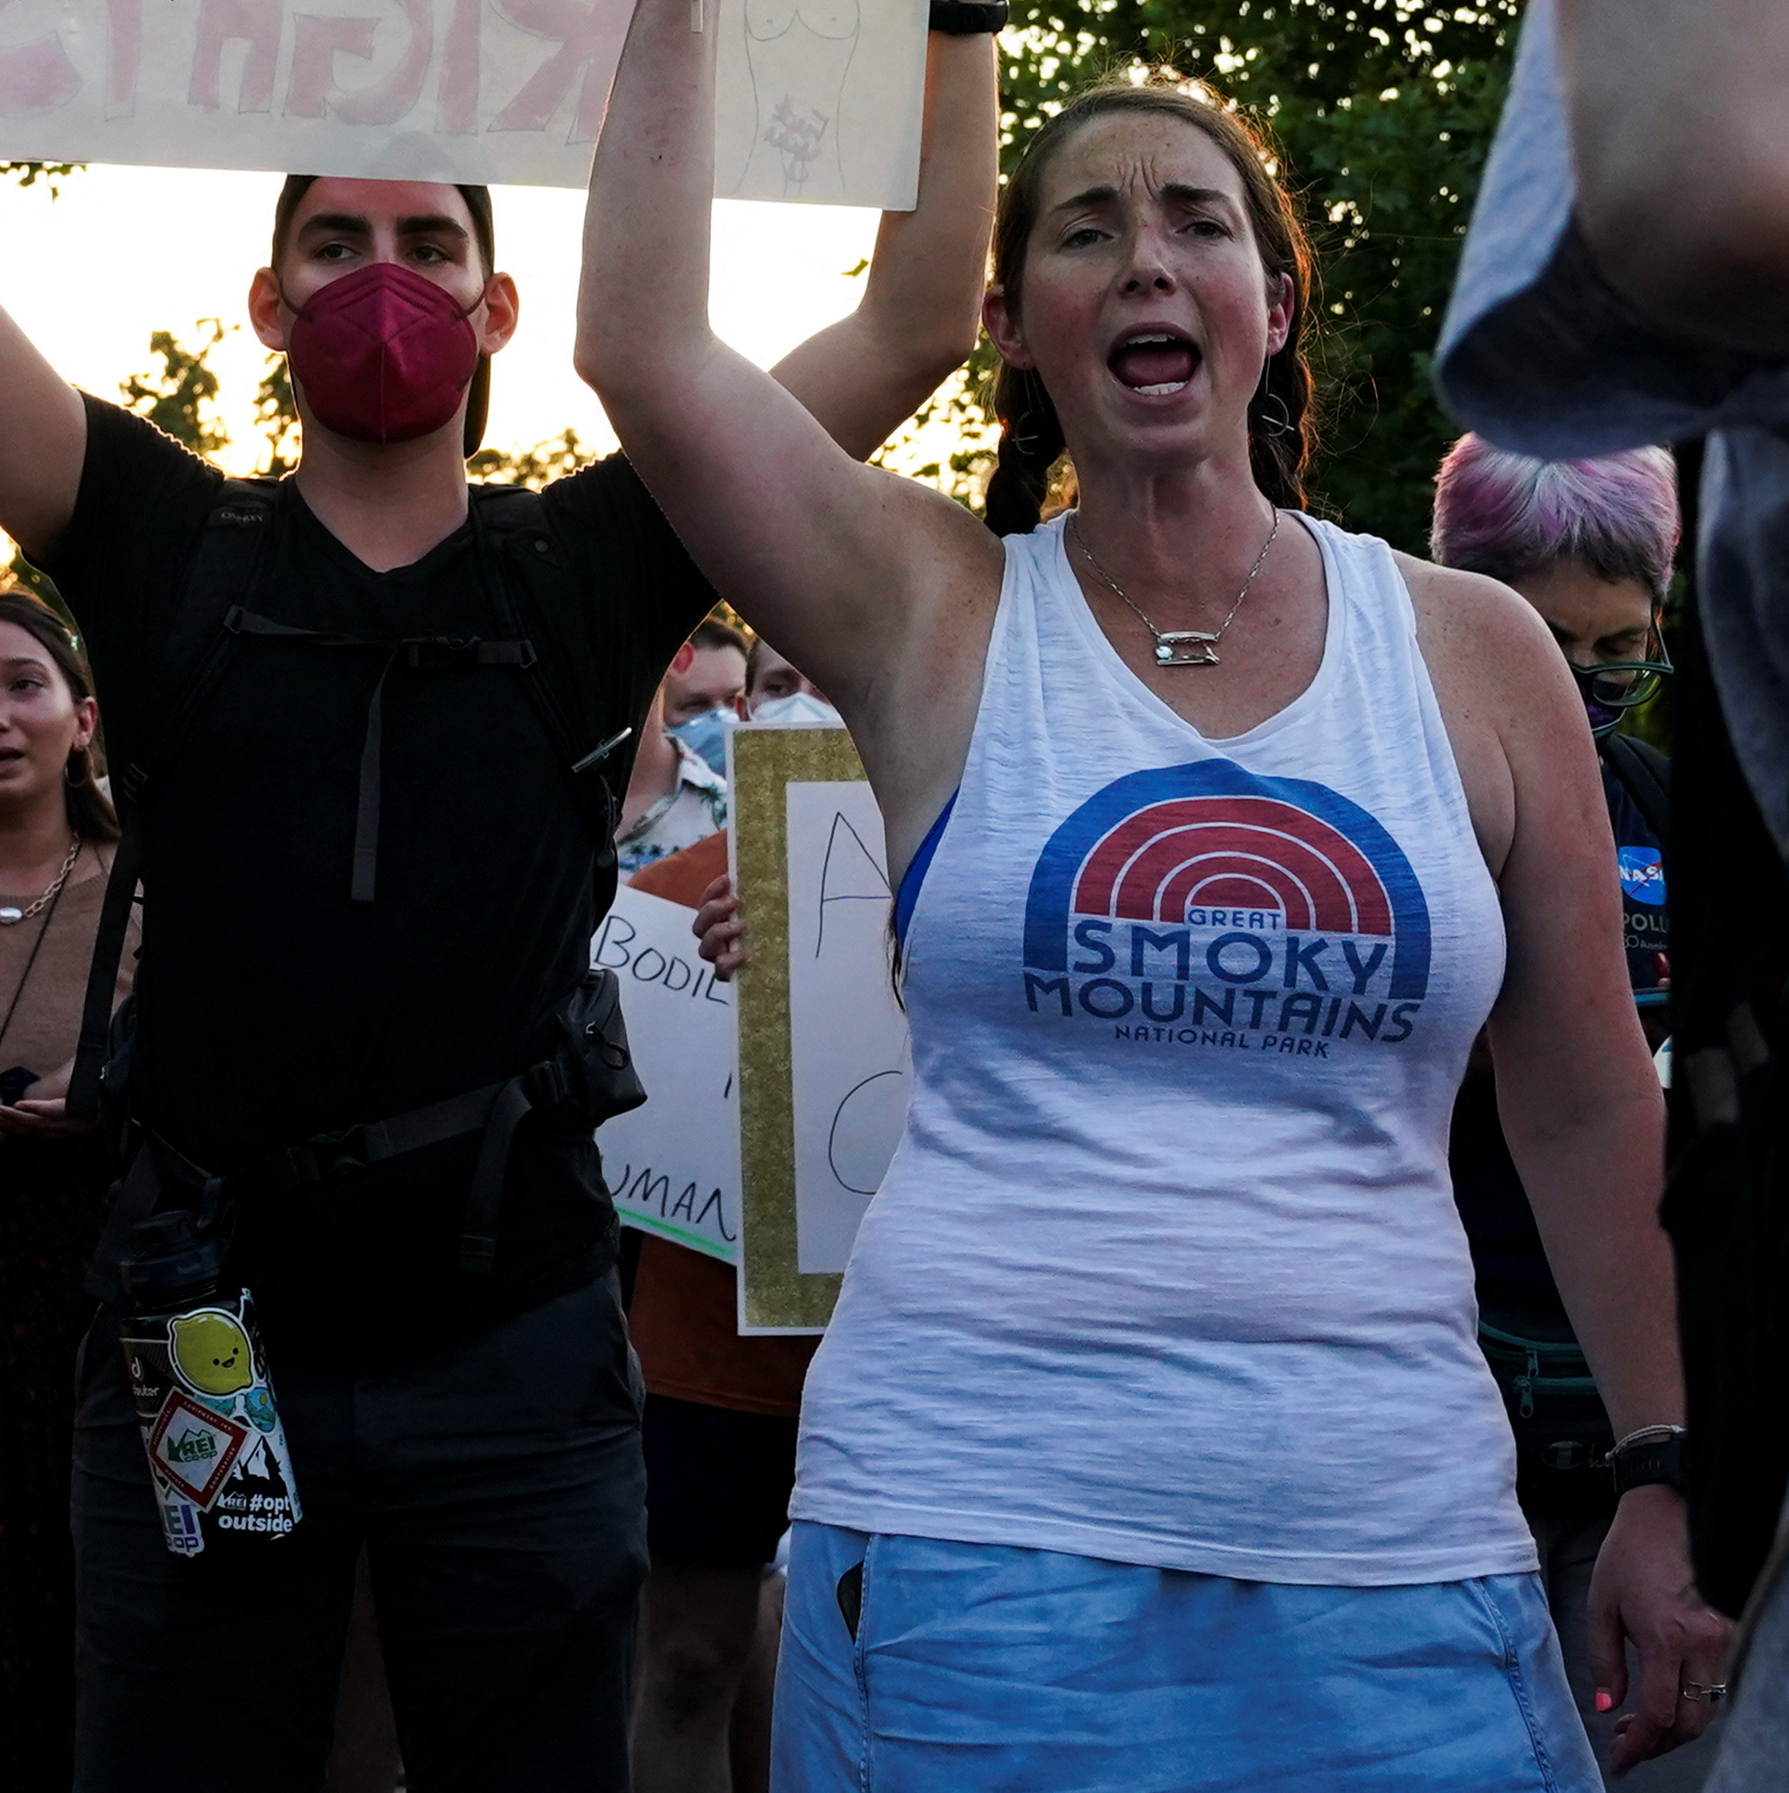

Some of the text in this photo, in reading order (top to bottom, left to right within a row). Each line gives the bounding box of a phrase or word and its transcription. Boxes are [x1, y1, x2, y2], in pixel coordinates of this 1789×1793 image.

[1187, 908, 1281, 930] GREAT
[595, 915, 729, 1005] BODIL
[1073, 919, 1388, 995] SMOKY
[1023, 972, 1421, 1043] MOUNTAINS
[1115, 1024, 1329, 1059] NATIONAL PARK
[249, 1494, 291, 1513] #opt
[218, 1513, 293, 1532] outside
